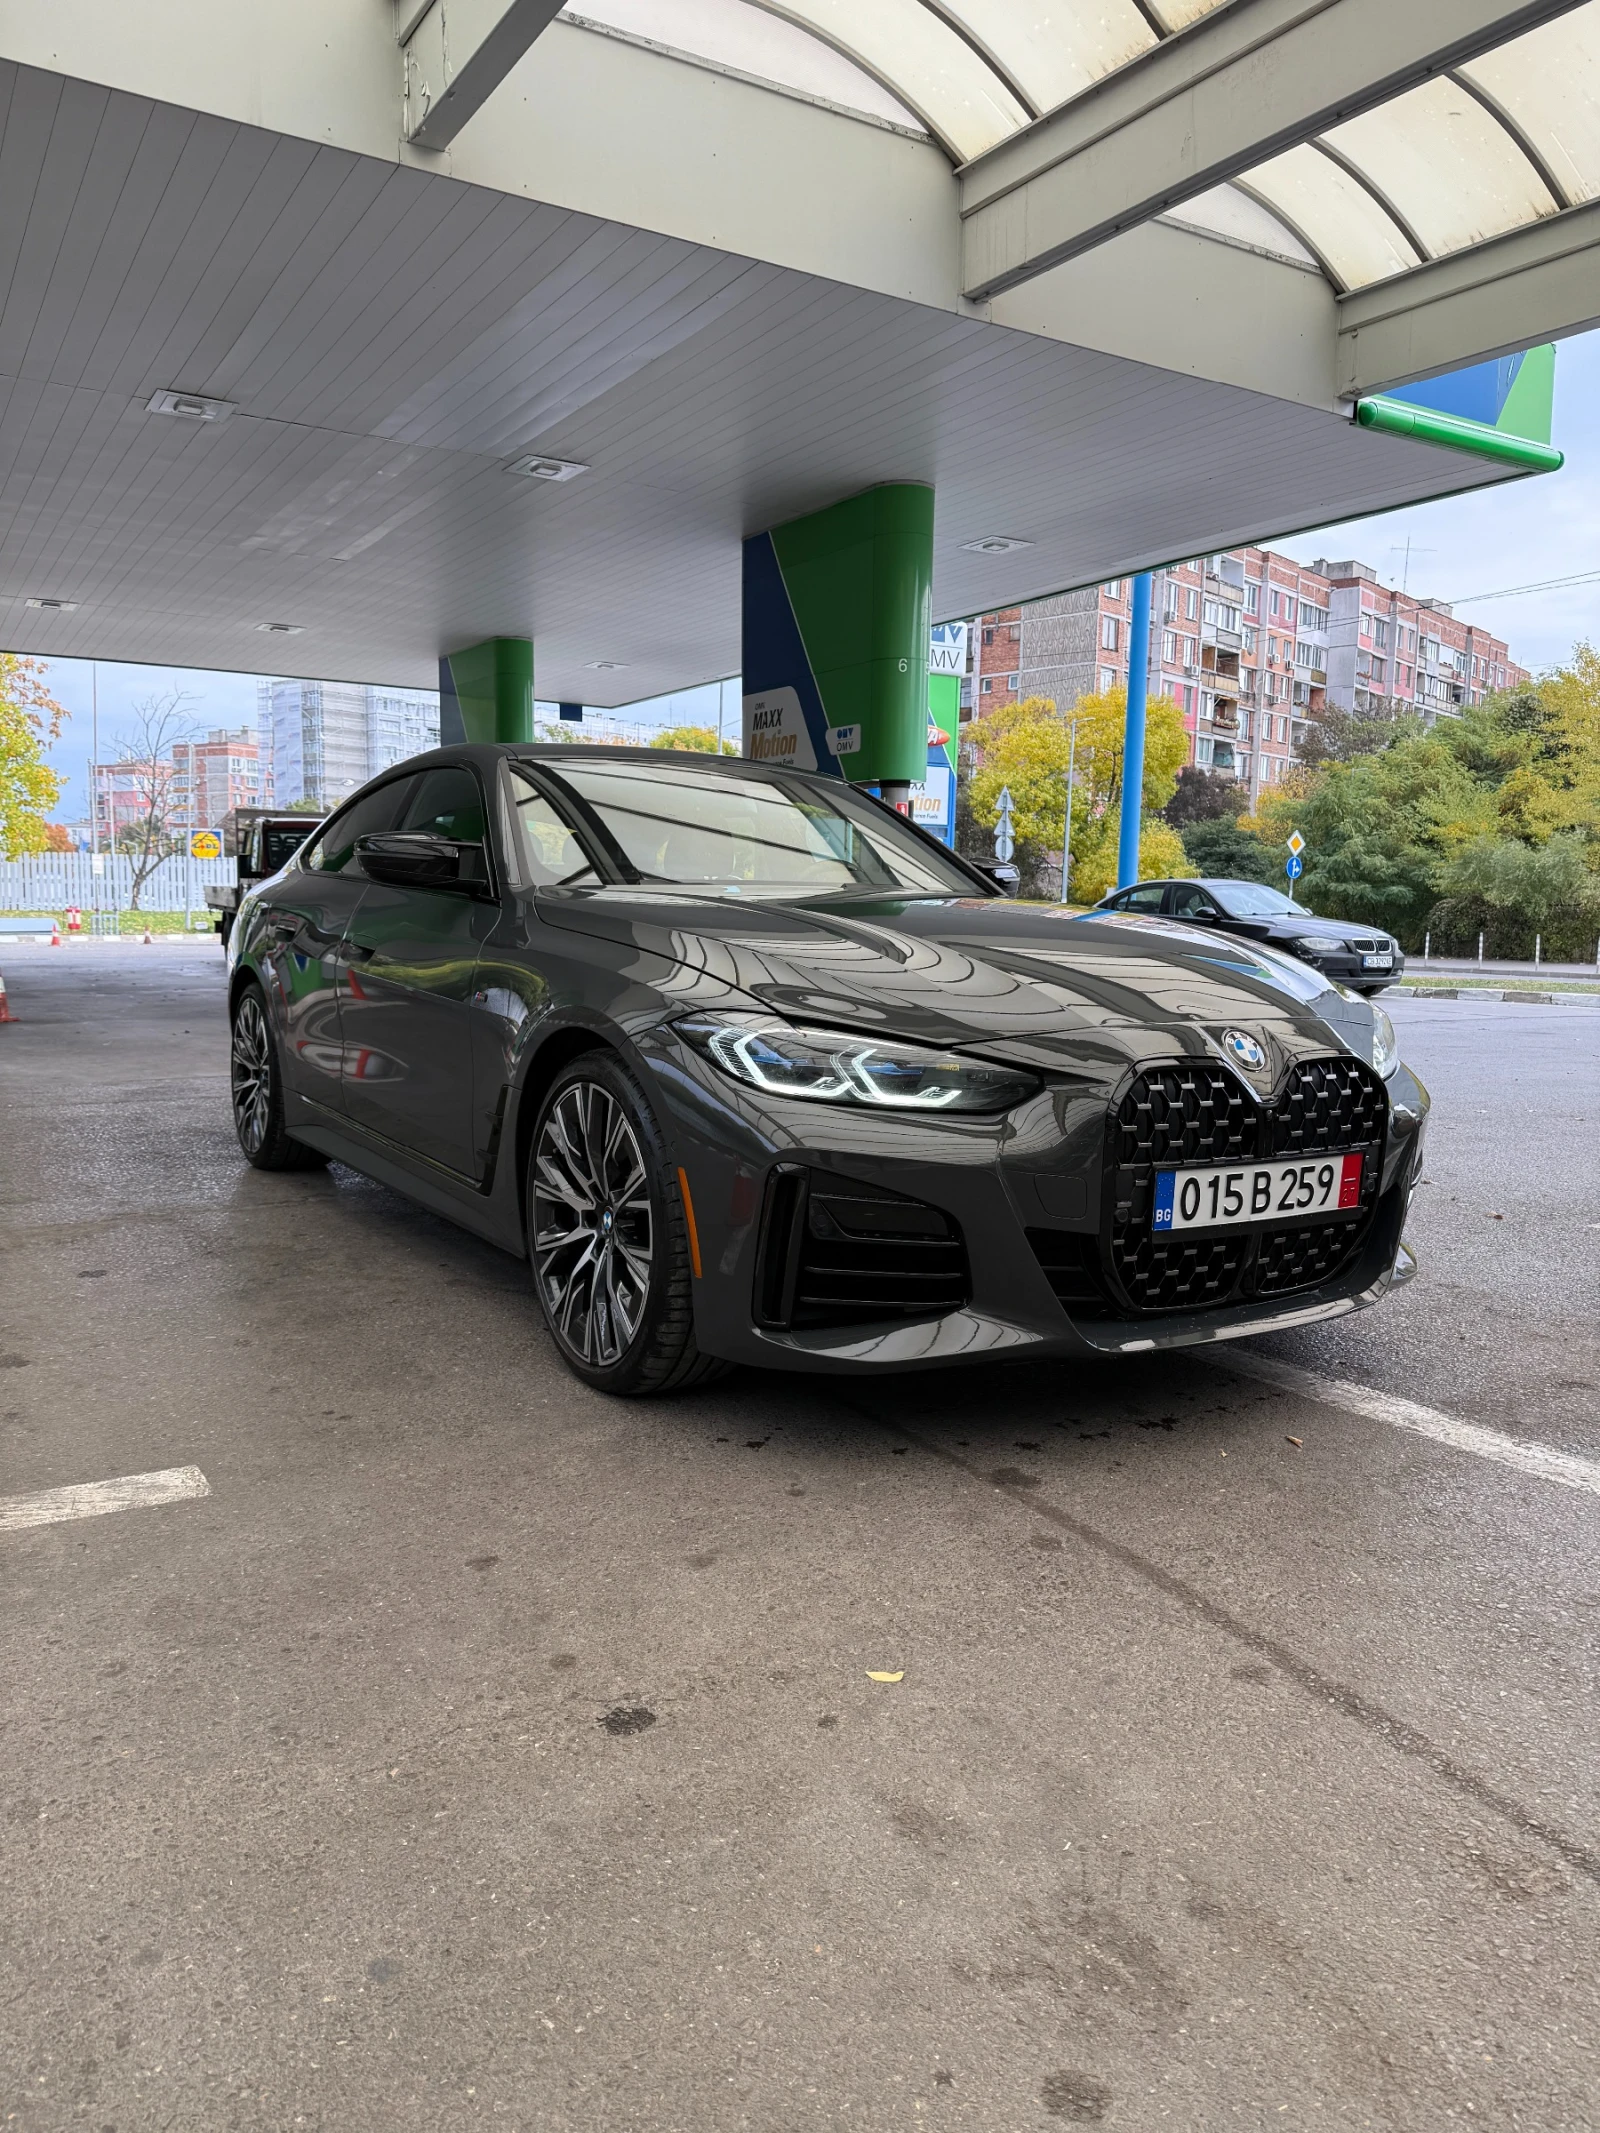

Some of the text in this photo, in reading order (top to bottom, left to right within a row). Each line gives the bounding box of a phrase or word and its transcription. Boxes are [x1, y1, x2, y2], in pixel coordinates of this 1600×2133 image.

[898, 658, 908, 673] 6
[931, 649, 960, 669] MV
[753, 708, 783, 731] MAXX
[750, 730, 797, 760] Motion
[836, 741, 854, 752] OMV
[914, 793, 941, 811] tion
[1155, 1208, 1171, 1223] BG
